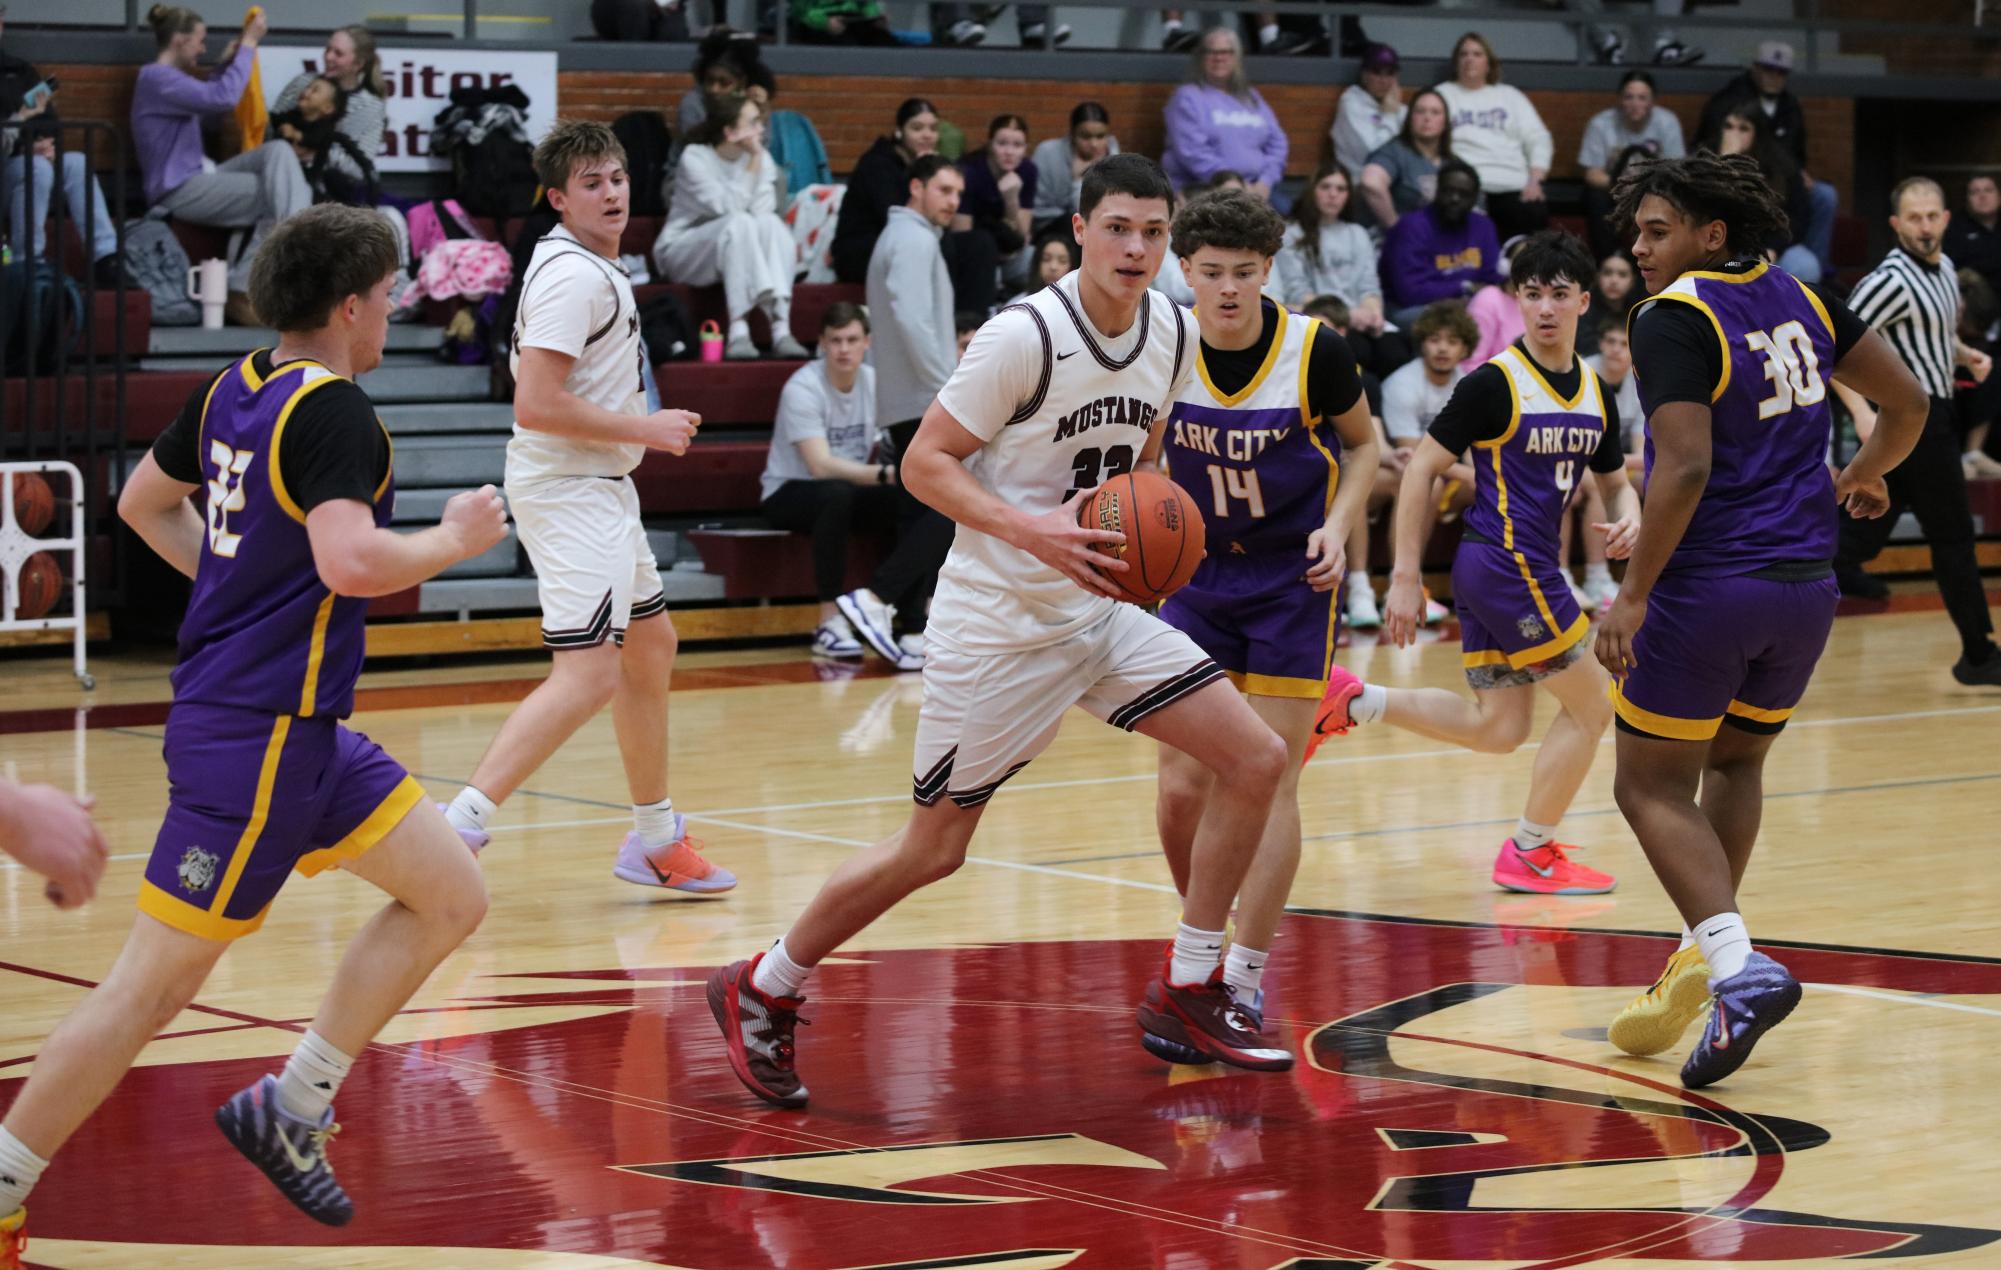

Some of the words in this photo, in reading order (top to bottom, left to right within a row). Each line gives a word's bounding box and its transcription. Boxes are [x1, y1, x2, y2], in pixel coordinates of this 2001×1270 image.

[1744, 320, 1826, 421] 30
[1053, 396, 1158, 442] MUSTANGS
[1174, 419, 1220, 457] ARK
[1226, 427, 1290, 462] CITY
[1525, 426, 1565, 454] ARK
[1567, 427, 1602, 455] CITY
[1206, 463, 1265, 518] 14
[1555, 460, 1574, 508] 4
